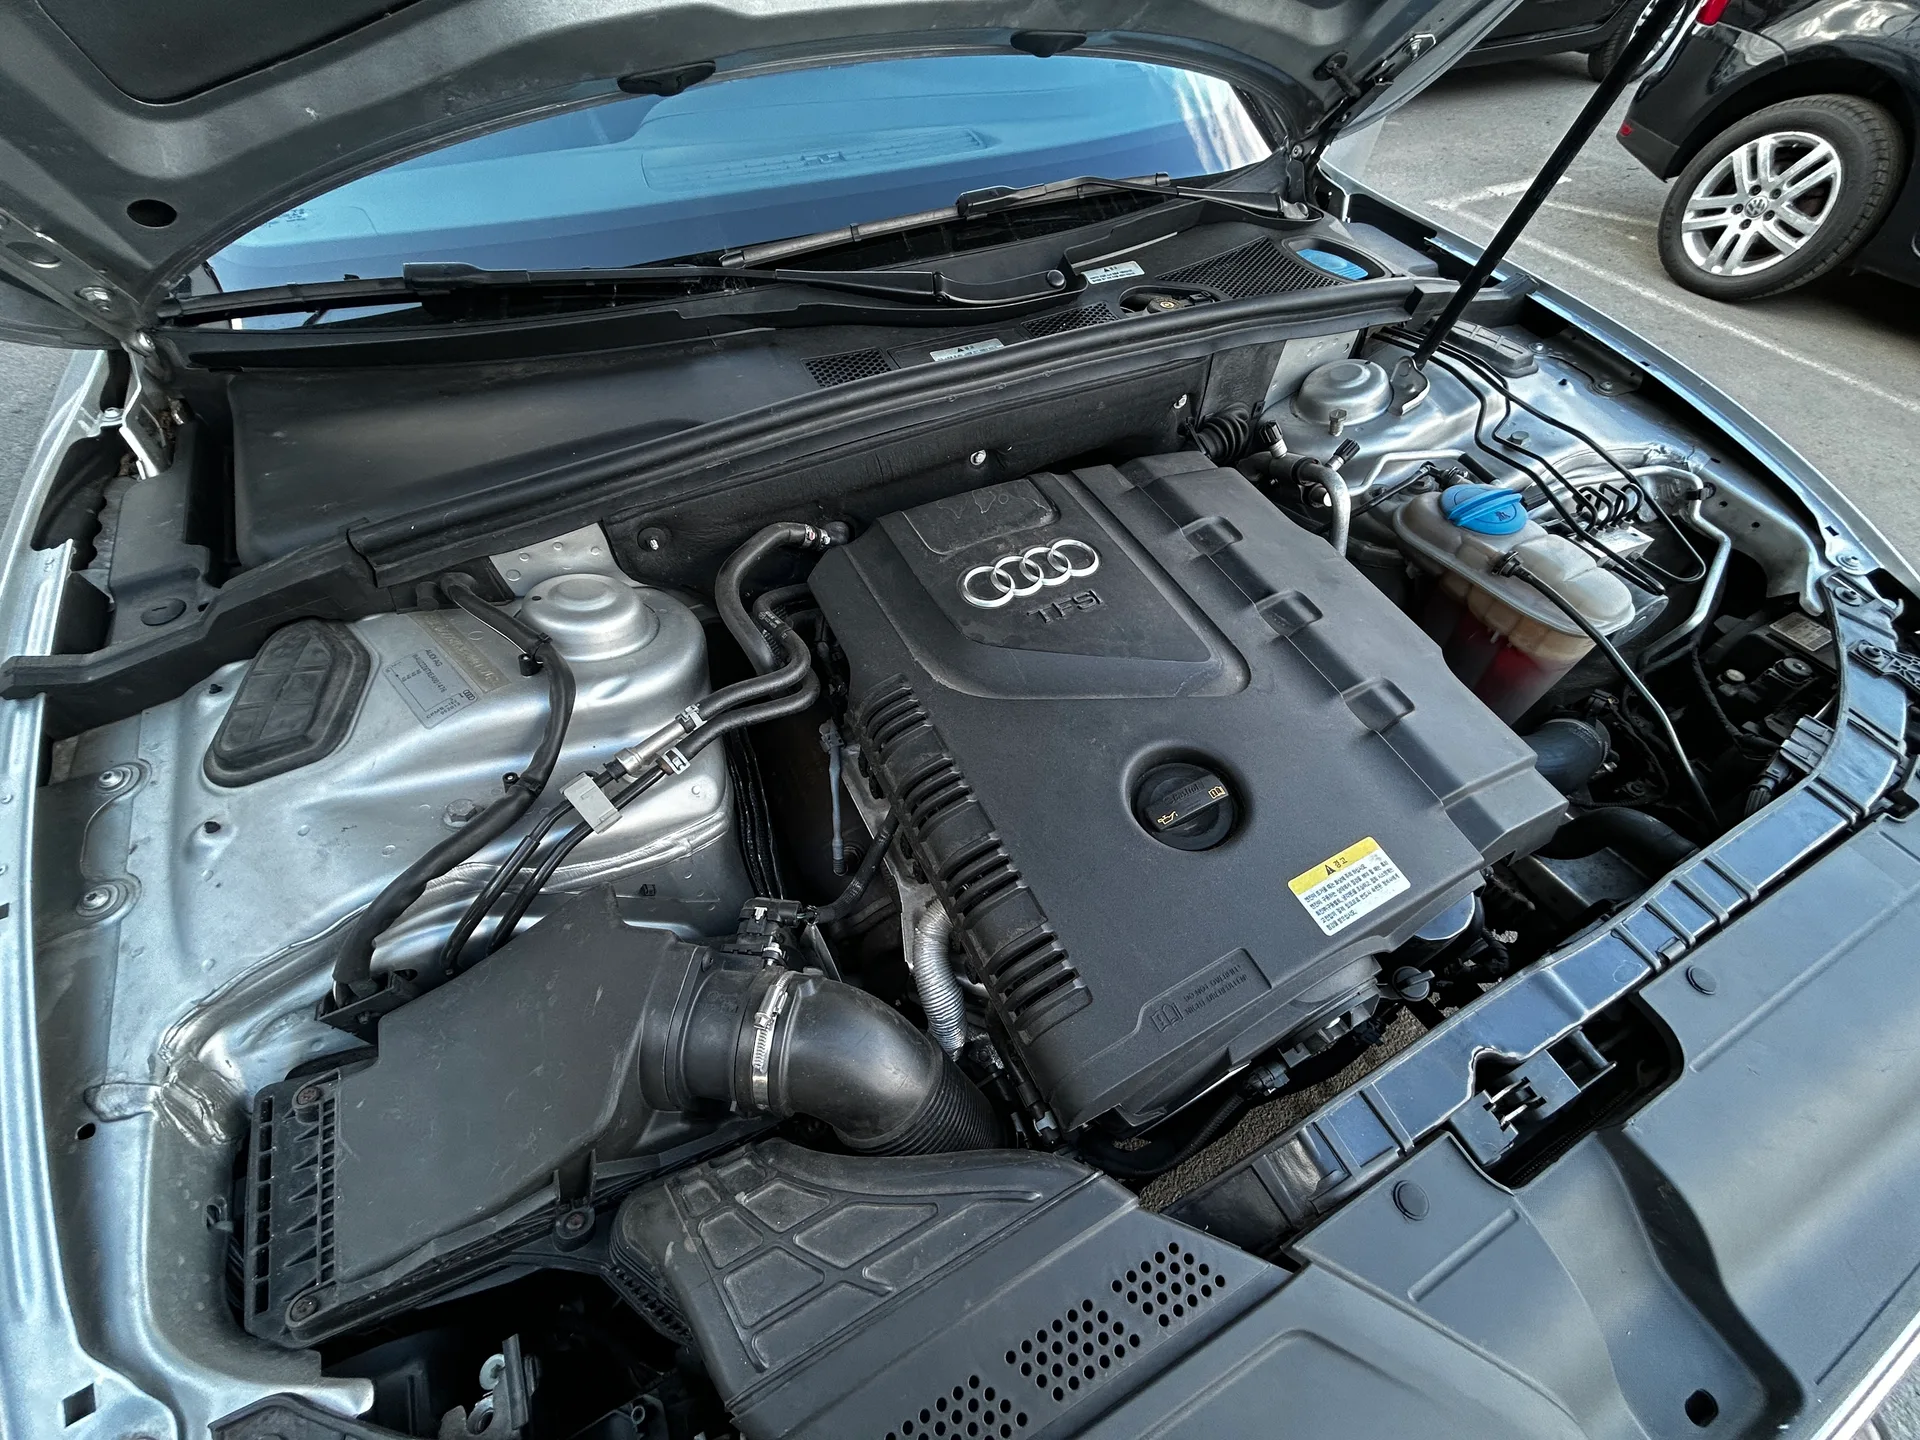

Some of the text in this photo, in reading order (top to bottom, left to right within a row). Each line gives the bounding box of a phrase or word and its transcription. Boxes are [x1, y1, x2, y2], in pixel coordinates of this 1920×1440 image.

[1026, 589, 1103, 624] TFSI
[425, 649, 443, 667] AUDI AG
[1332, 857, 1348, 868] 경고
